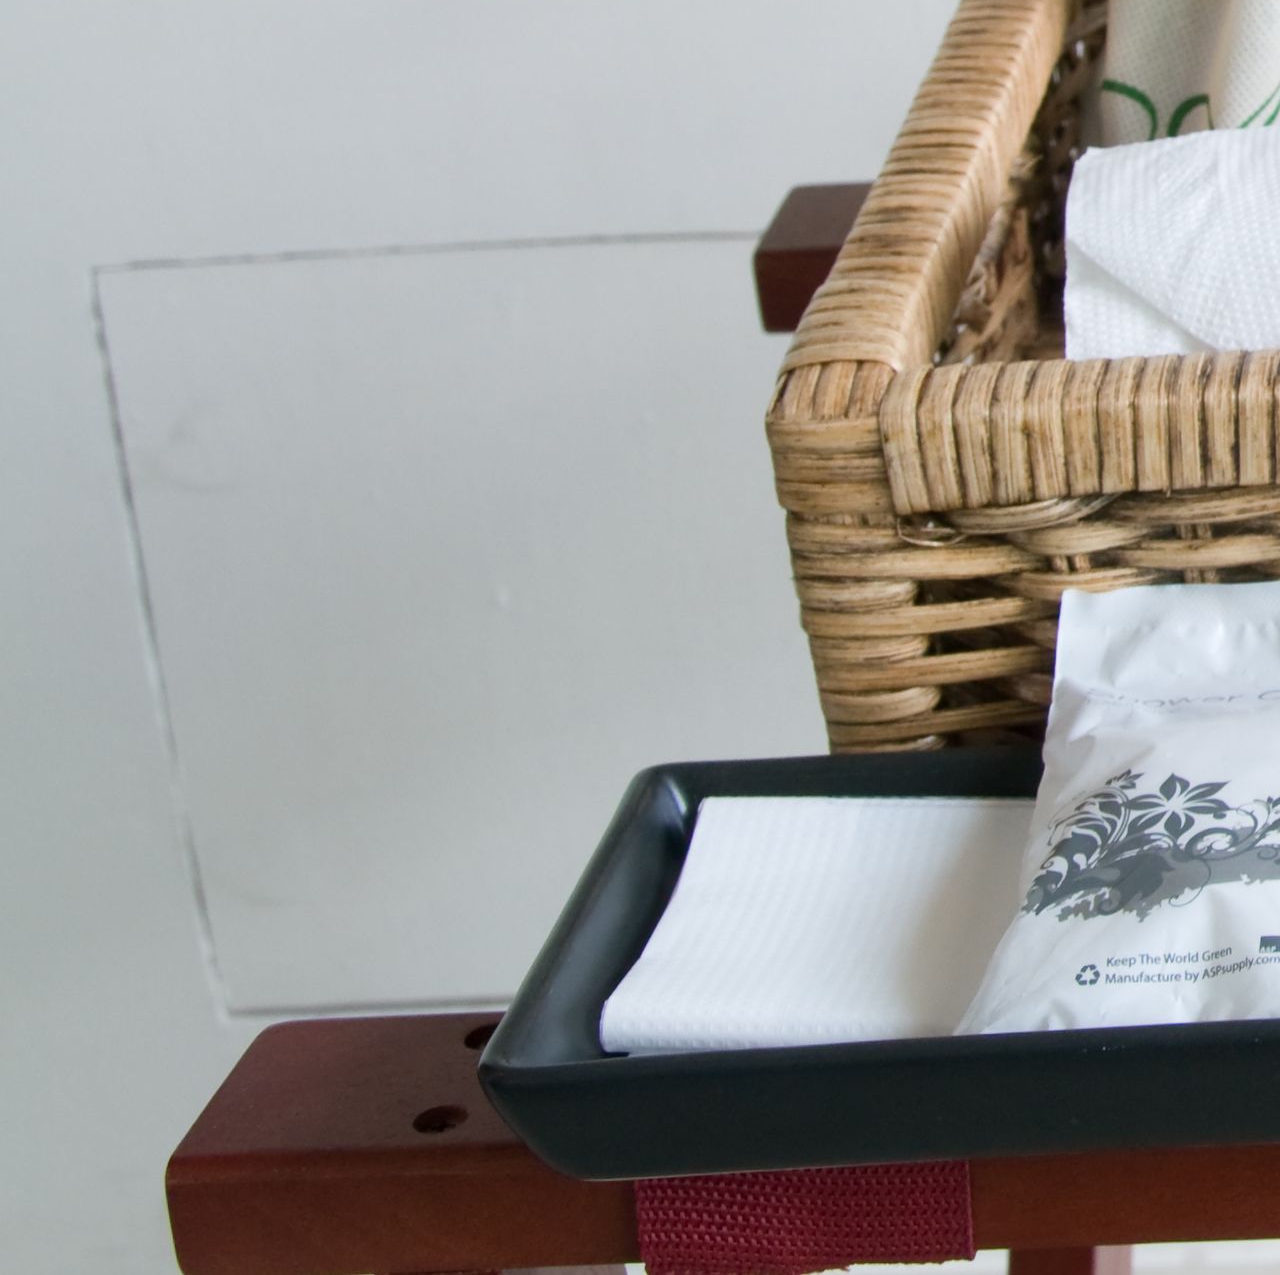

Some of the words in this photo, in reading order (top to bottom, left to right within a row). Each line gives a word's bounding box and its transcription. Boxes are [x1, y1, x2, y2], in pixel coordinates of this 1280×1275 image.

[1106, 956, 1137, 968] Keep
[1138, 953, 1162, 966] The
[1163, 952, 1200, 965] World
[1201, 946, 1233, 963] Green
[1104, 970, 1182, 985] Manufacture
[1184, 969, 1200, 984] by
